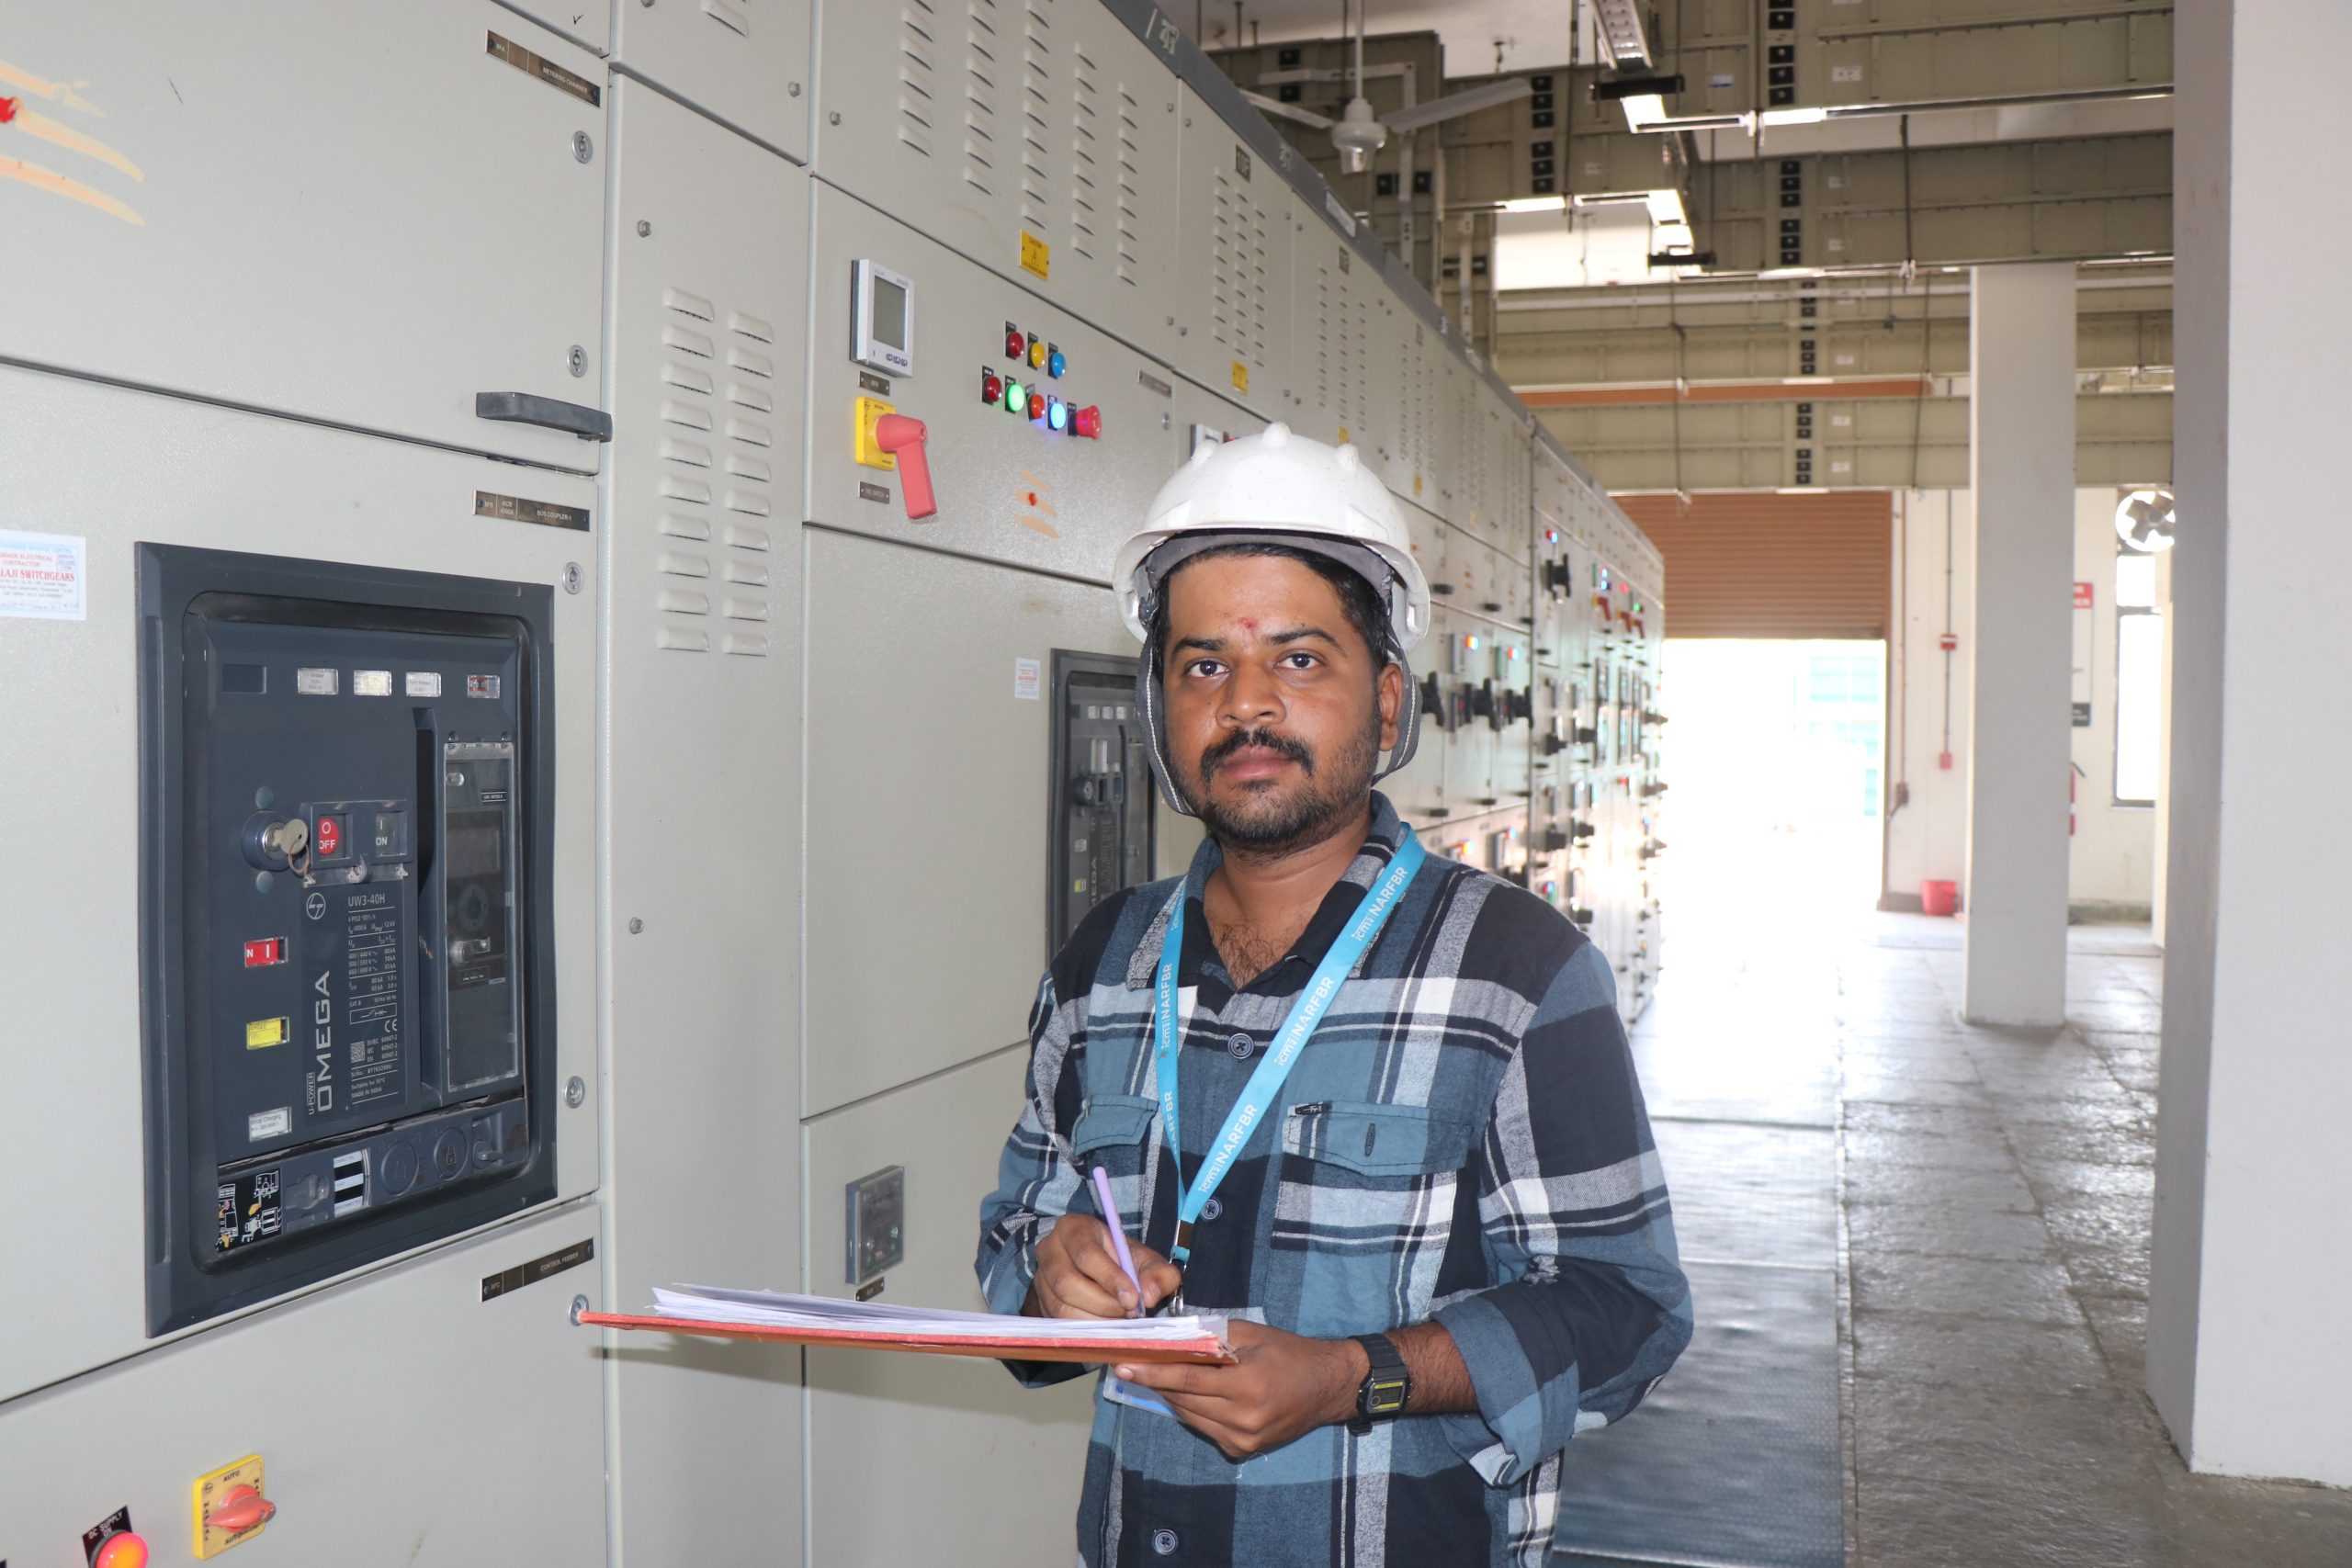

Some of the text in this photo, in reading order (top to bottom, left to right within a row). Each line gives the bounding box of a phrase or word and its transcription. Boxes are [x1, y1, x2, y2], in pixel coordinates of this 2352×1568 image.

[542, 66, 588, 93] METERING CHAMBER
[502, 500, 513, 508] ACB
[20, 553, 52, 561] ELECTRICAL
[0, 569, 74, 581] LAJI SWITCHGEARS
[318, 837, 388, 850] OFF ON
[348, 893, 385, 907] UW3-40H
[1368, 867, 1408, 917] NARFBR
[1160, 962, 1173, 1015] NARFBR
[1292, 976, 1335, 1037] NARFBR
[314, 970, 332, 1112] OMEGA
[1215, 1103, 1259, 1165] NARFBR
[540, 1251, 579, 1271] CONTROL FEEDER
[223, 1470, 241, 1482] AUTO
[88, 1510, 122, 1539] DC SUPPLY
